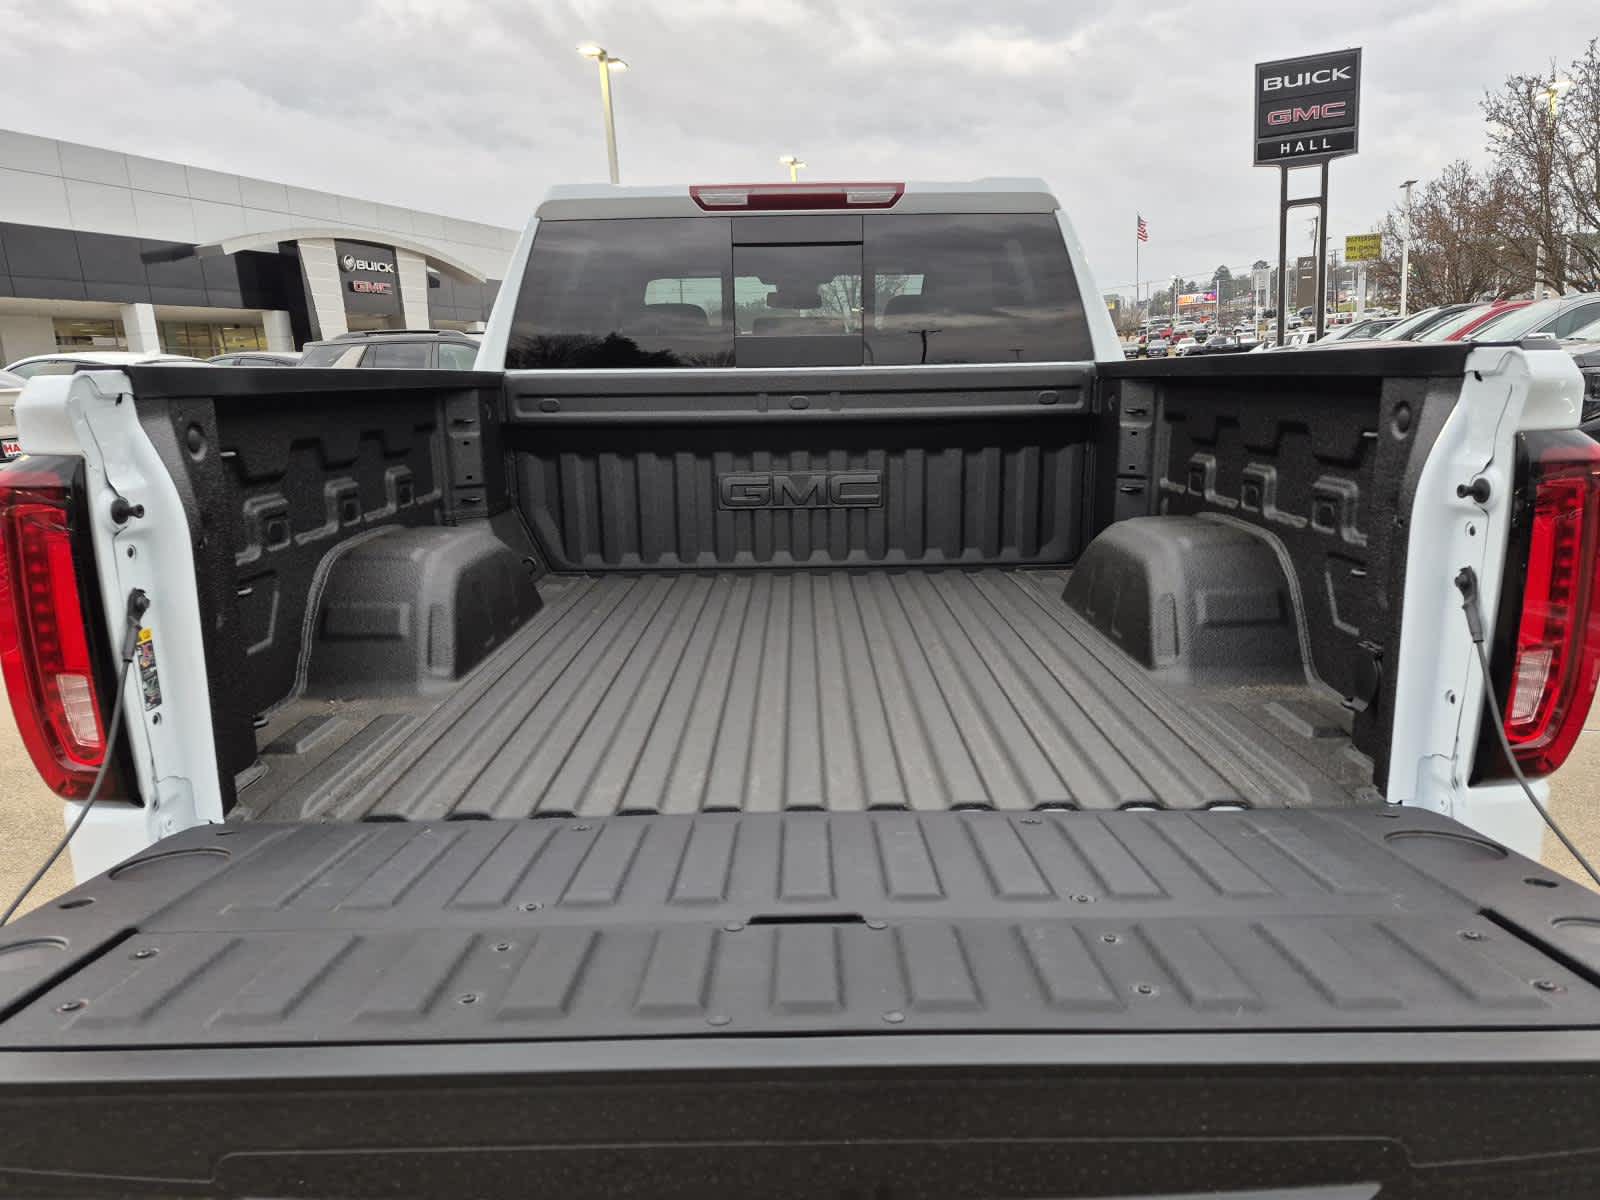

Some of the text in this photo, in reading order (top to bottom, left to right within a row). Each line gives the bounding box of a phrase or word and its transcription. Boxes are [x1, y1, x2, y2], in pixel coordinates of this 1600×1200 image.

[1263, 65, 1351, 91] BUICK
[1267, 101, 1346, 125] GMC
[1280, 138, 1331, 154] HALL
[356, 259, 394, 273] BUICK
[353, 280, 393, 294] GMC
[3, 443, 22, 453] HA
[719, 472, 882, 508] GMC
